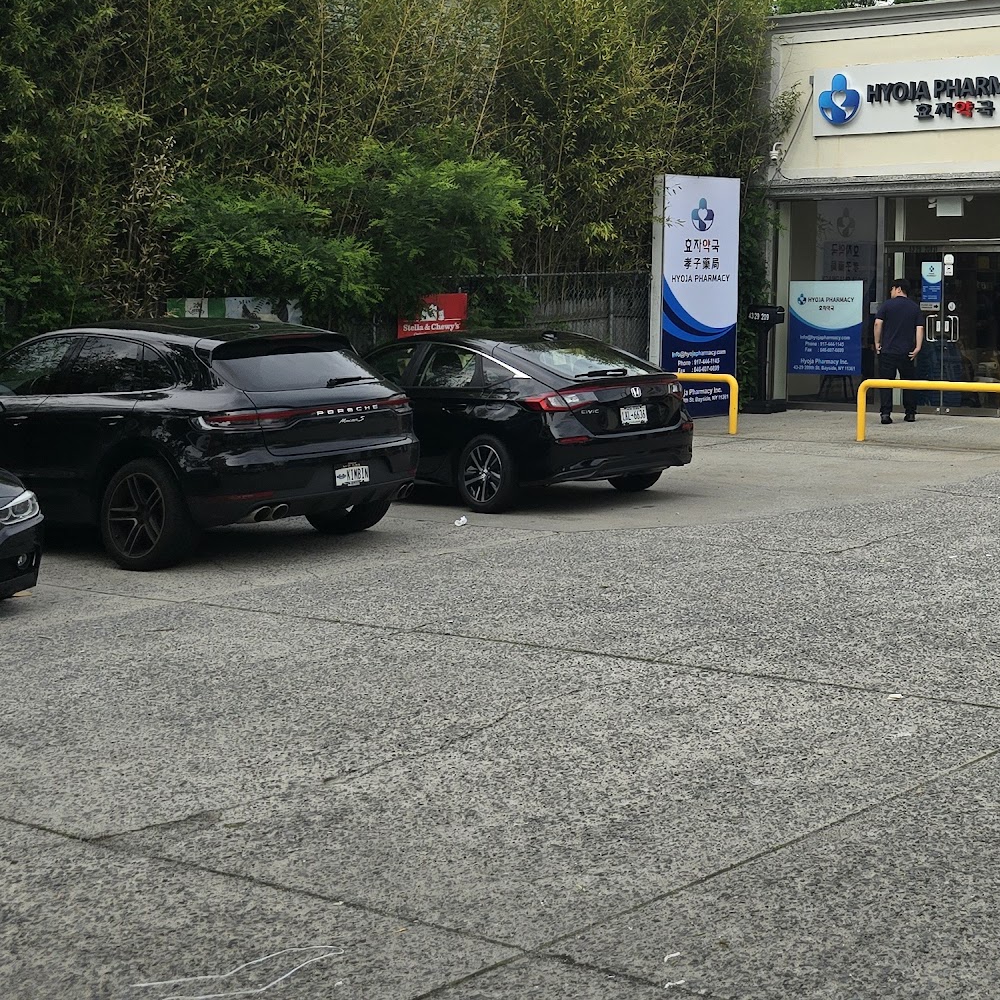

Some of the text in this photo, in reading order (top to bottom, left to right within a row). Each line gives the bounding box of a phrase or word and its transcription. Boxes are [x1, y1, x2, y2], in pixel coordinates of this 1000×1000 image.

[866, 80, 931, 103] HYOJA
[913, 100, 996, 121] 효자약국
[683, 238, 720, 253] 효자약국
[671, 274, 730, 283] HYOJA PHARMACY
[403, 322, 461, 332] Stella & Chewy's
[316, 404, 379, 416] PORSCHE
